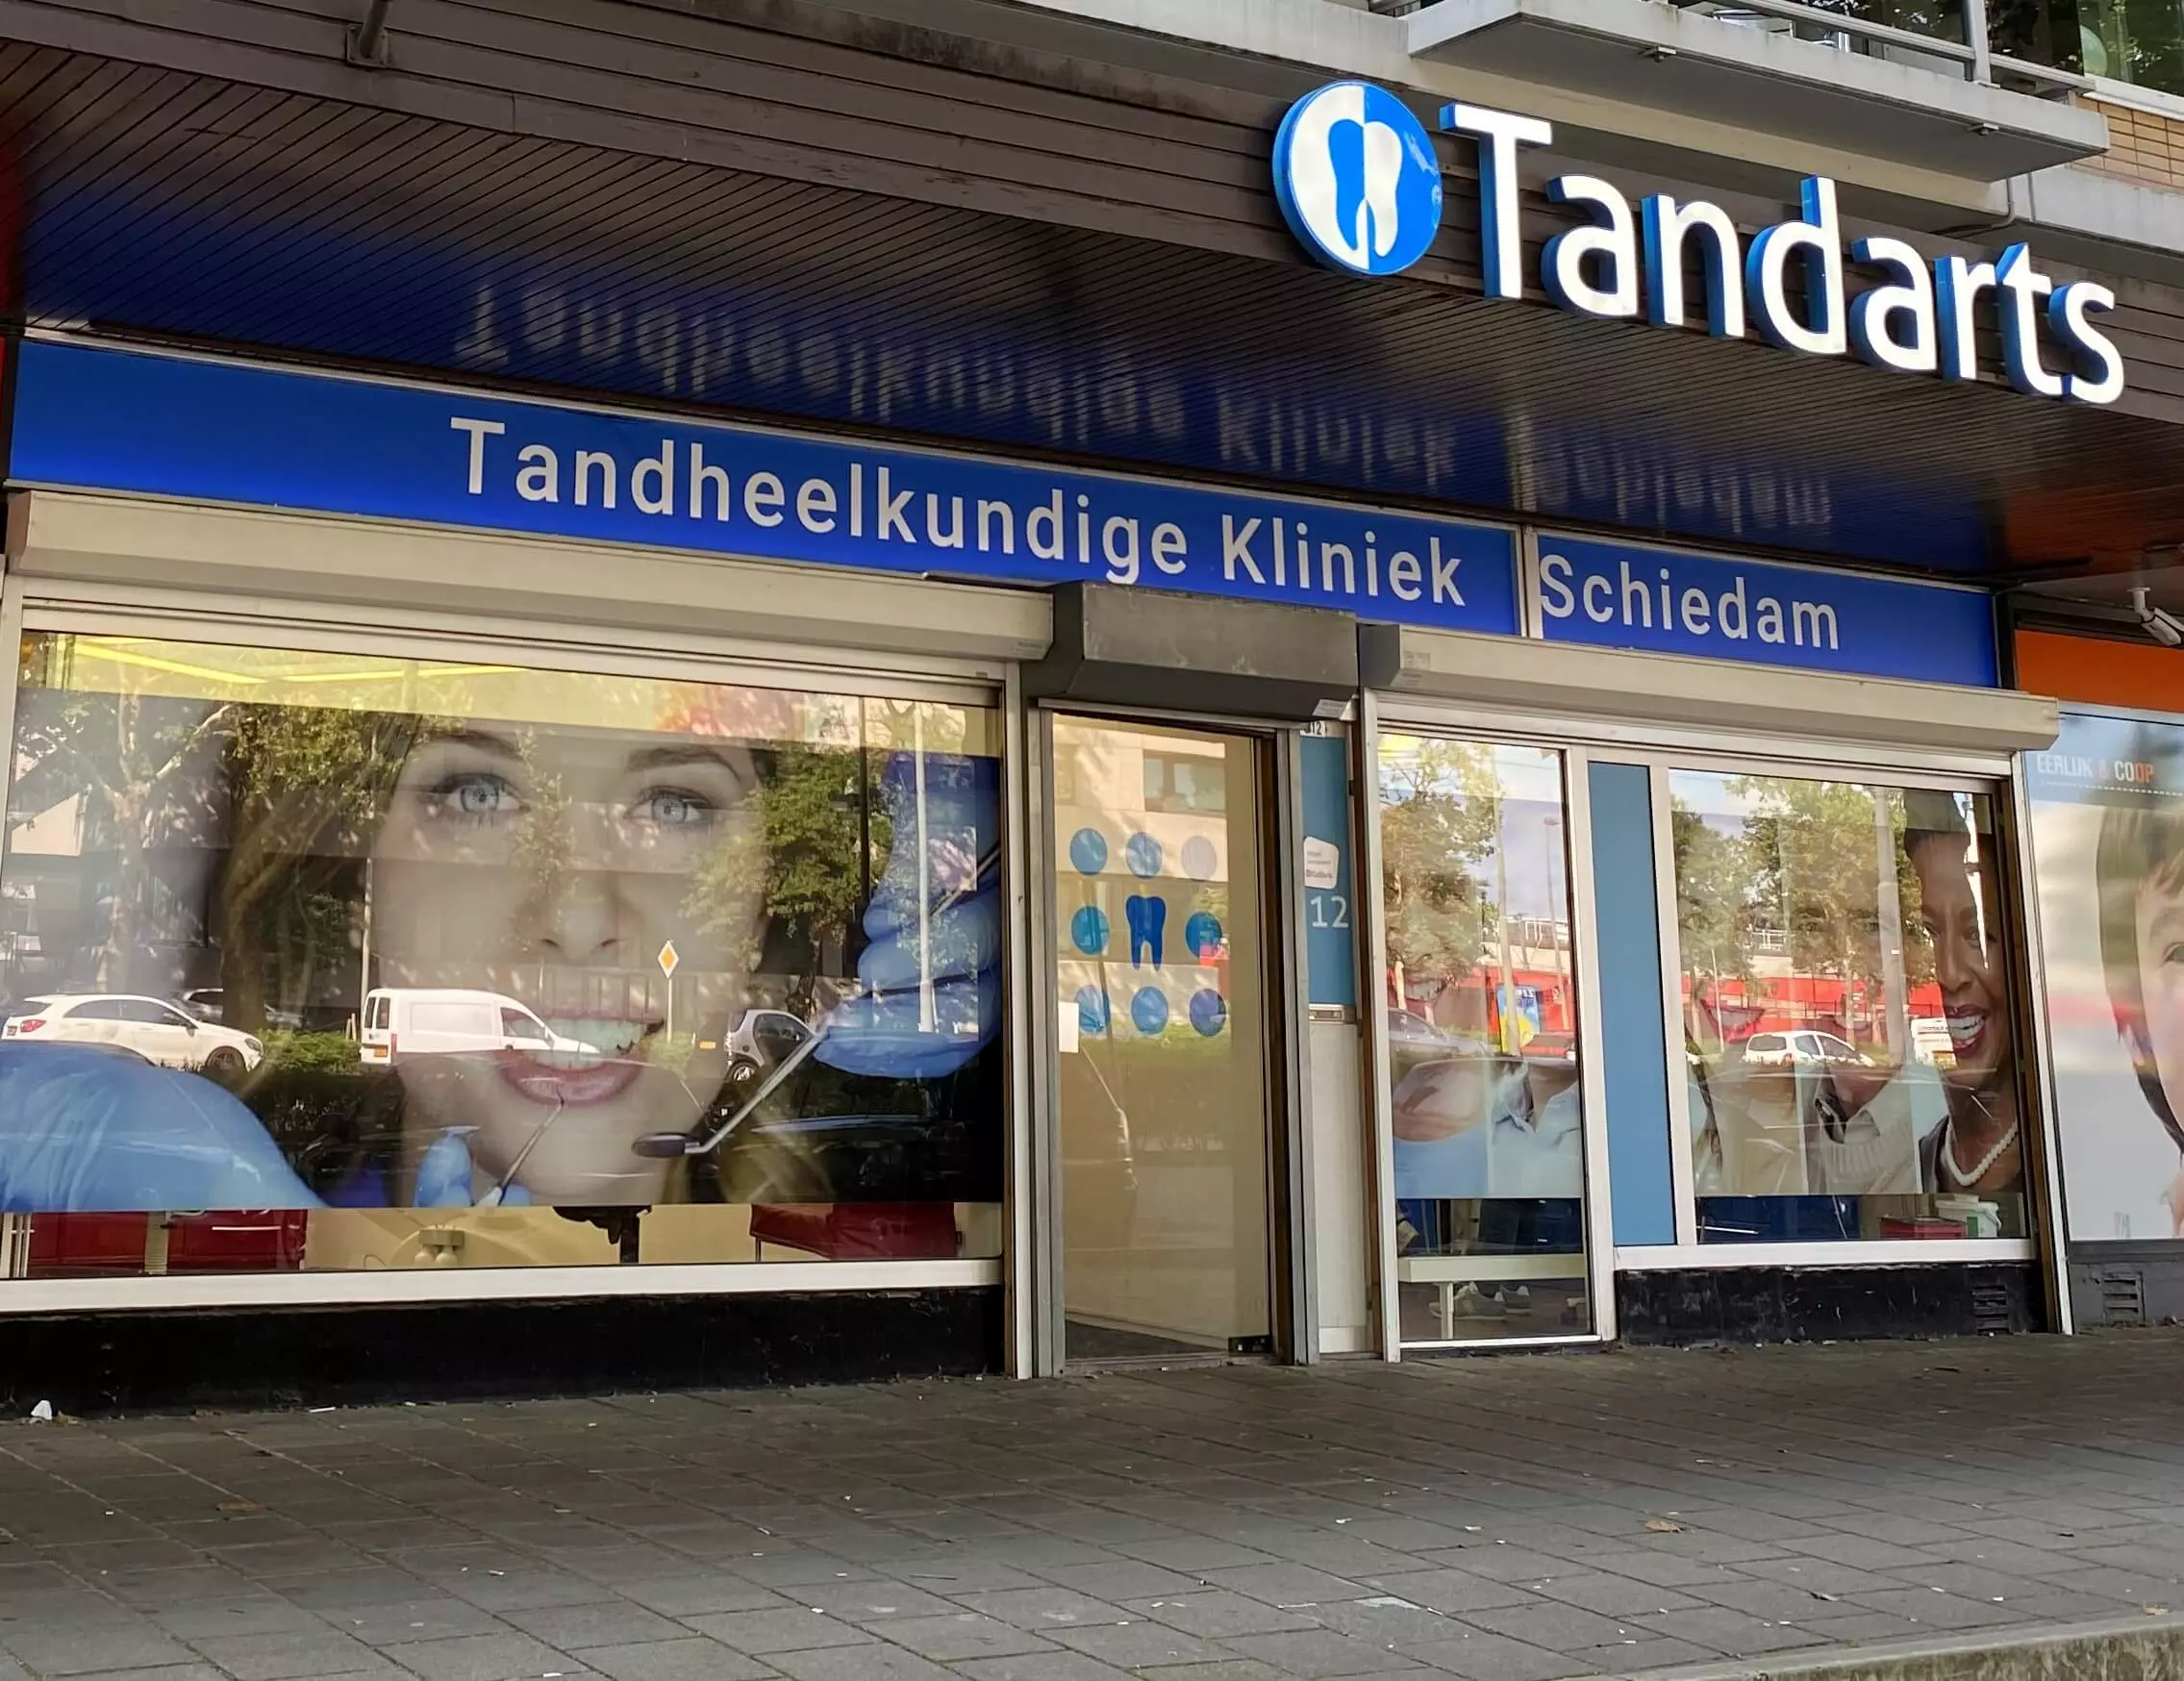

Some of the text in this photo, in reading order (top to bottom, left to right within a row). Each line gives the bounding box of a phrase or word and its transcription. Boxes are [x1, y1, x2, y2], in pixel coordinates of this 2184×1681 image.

[1442, 103, 2125, 405] Tandarts
[450, 416, 1840, 651] Tandheelkundige Kliniek Schiedam
[2114, 760, 2155, 784] COOP
[1310, 895, 1349, 928] 12
